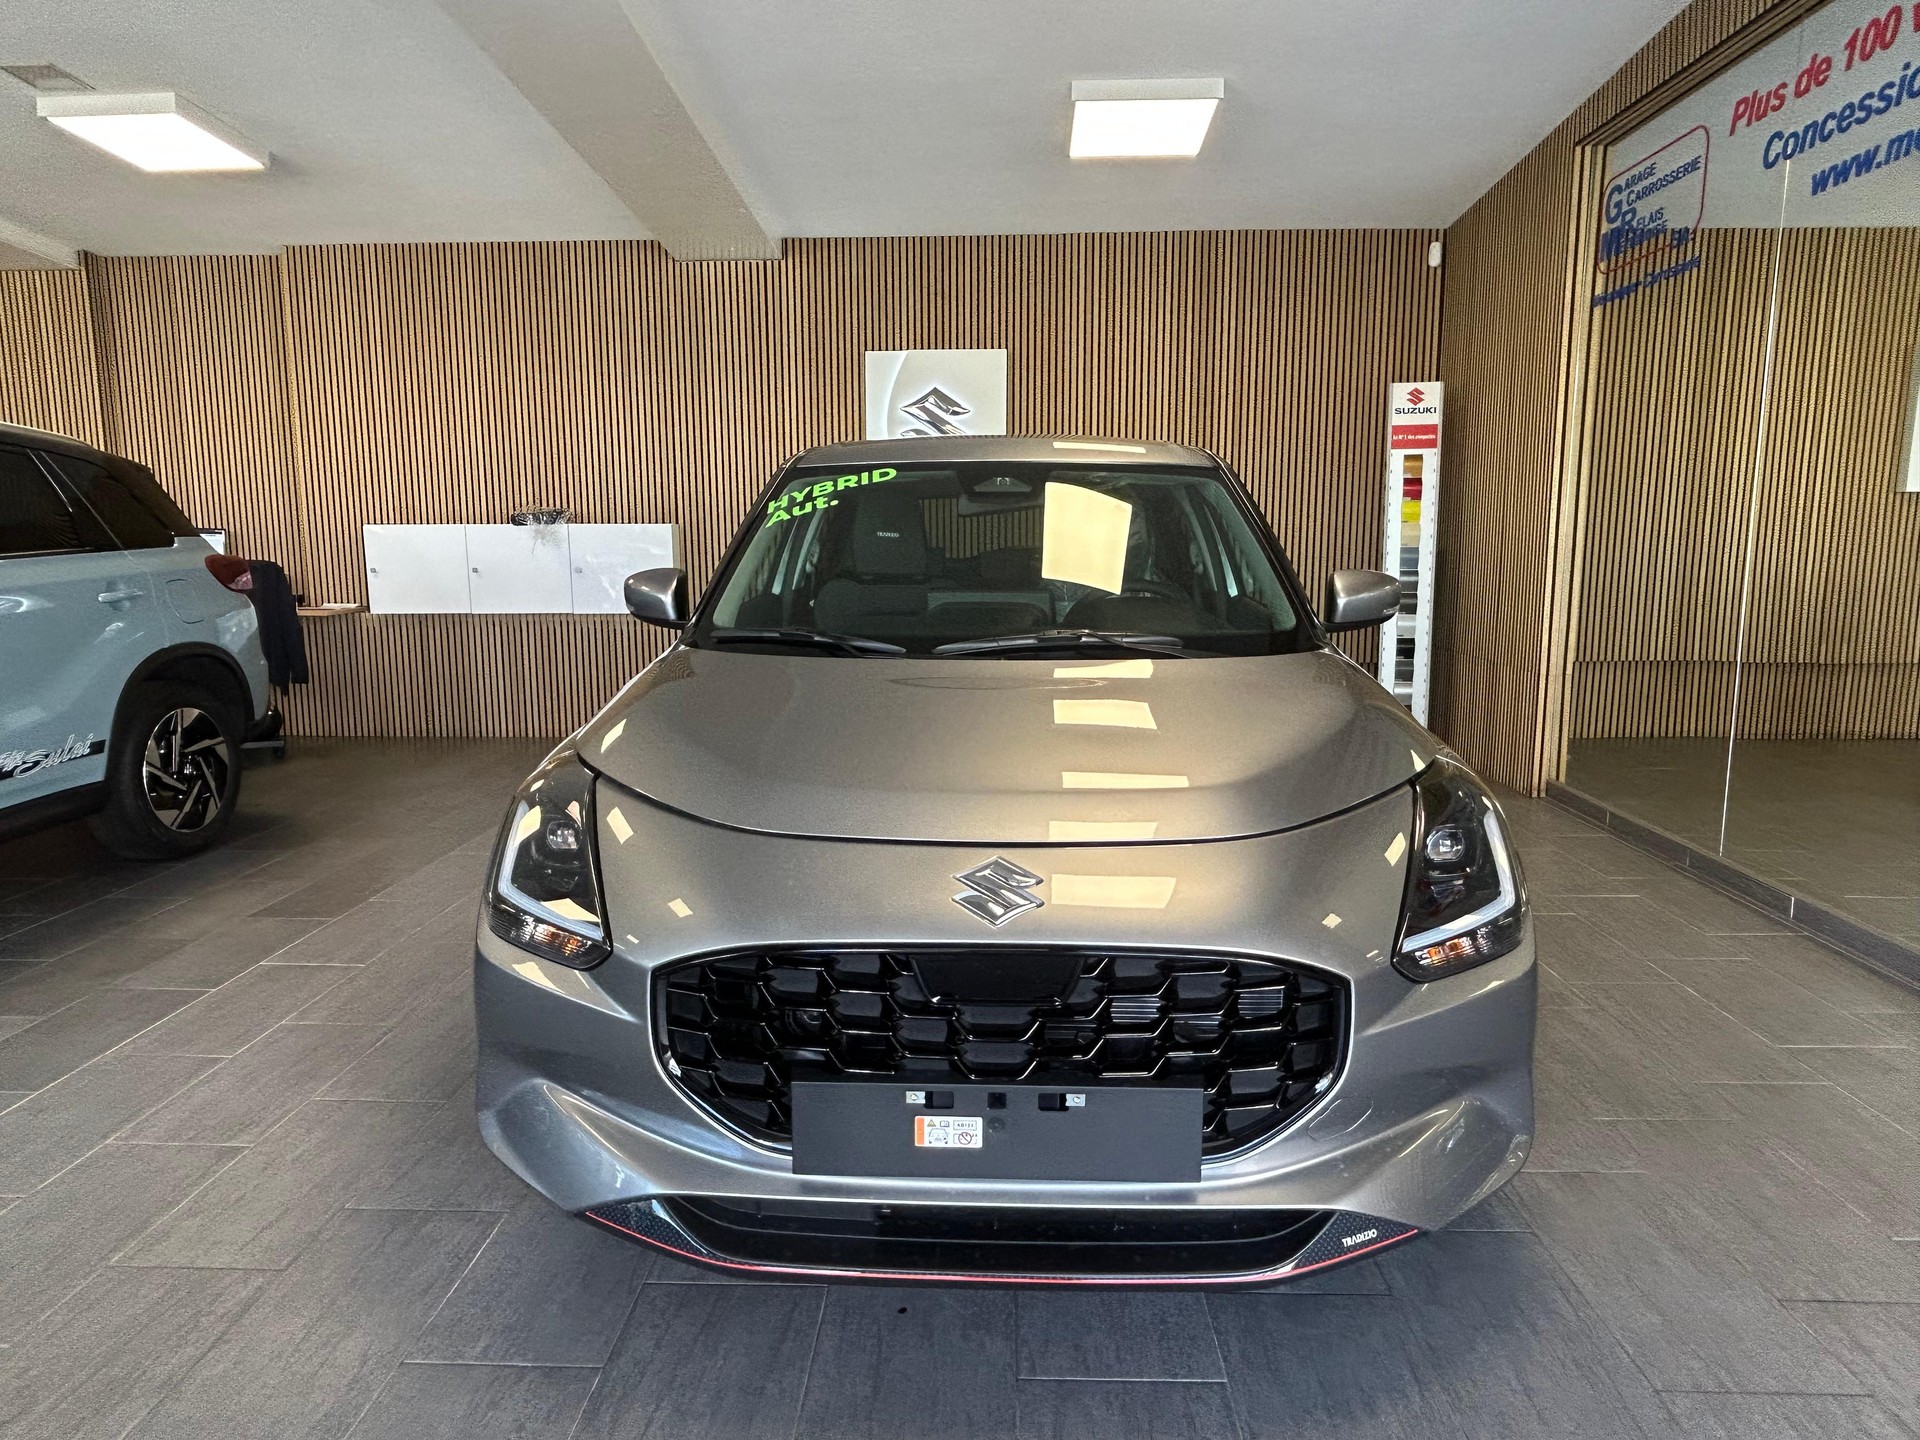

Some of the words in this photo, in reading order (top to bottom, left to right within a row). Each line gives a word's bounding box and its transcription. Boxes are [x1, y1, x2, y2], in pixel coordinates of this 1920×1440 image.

[1729, 82, 1788, 136] Plus
[1794, 53, 1832, 98] de
[1844, 5, 1902, 71] 100
[1626, 156, 1701, 207] CARROSSERIE
[1394, 406, 1437, 415] SUZUKI
[767, 468, 897, 514] HYBRID
[765, 495, 839, 528] Aut.
[1341, 1228, 1378, 1248] TRADIZIO
